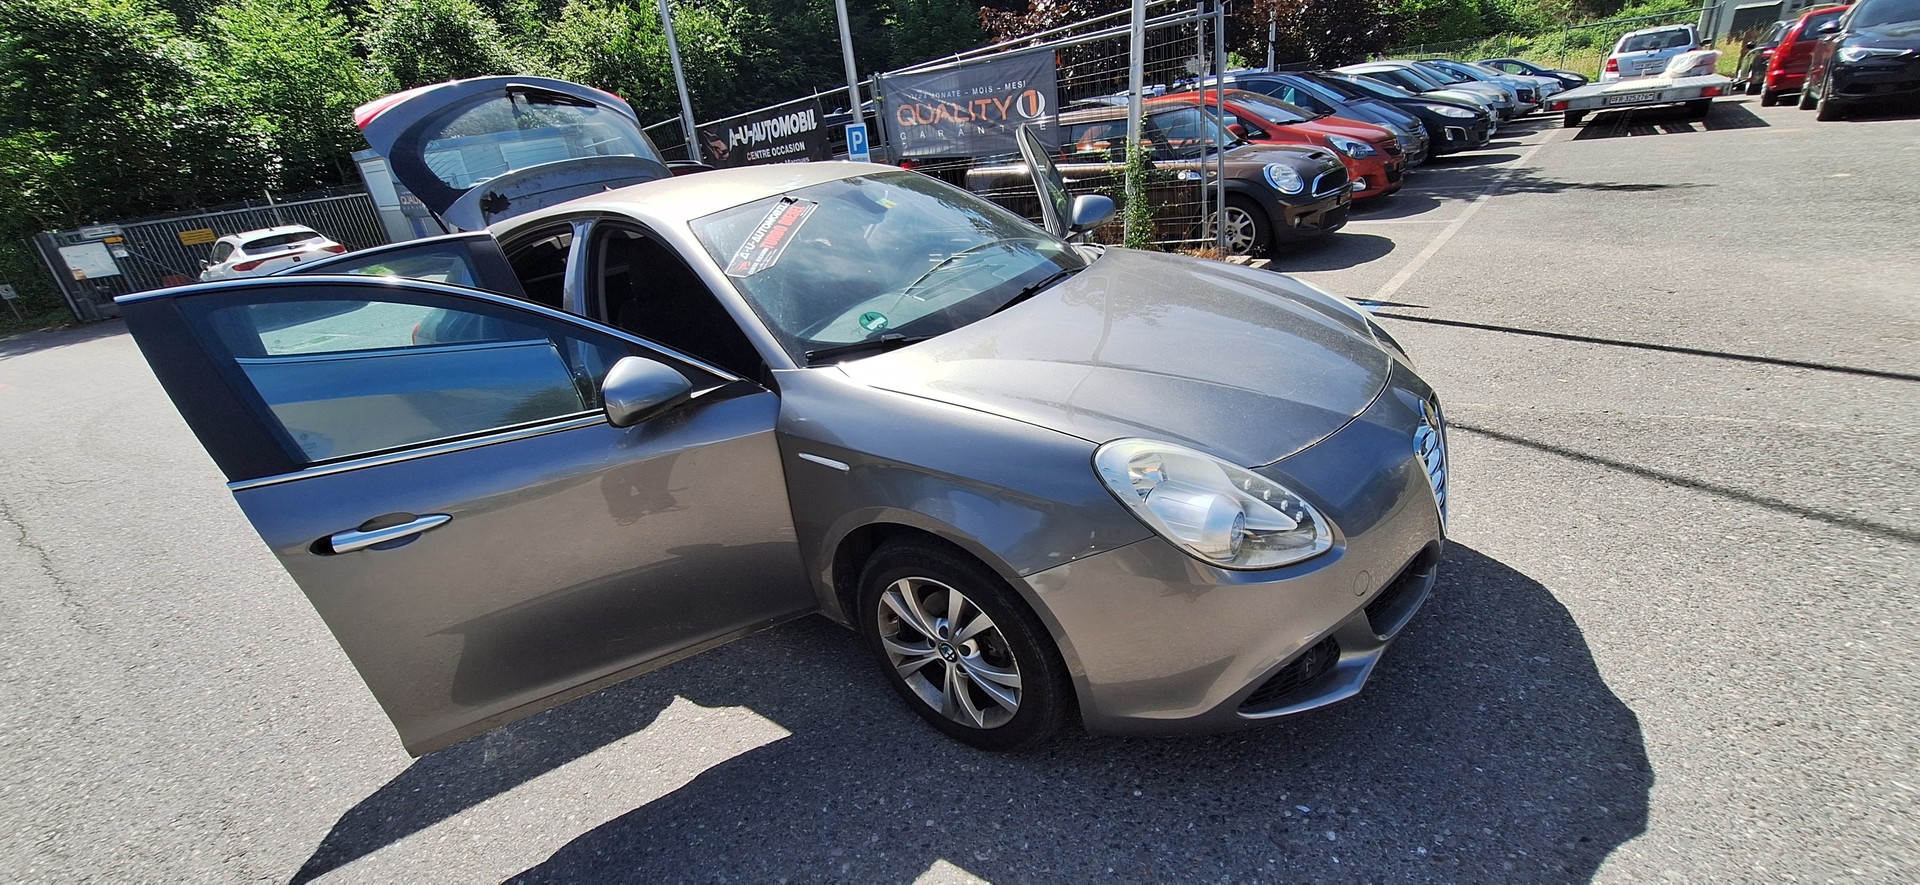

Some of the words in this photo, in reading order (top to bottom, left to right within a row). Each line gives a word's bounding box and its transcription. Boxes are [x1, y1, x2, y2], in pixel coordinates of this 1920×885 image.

[972, 86, 993, 95] MOIS
[1004, 80, 1026, 91] MESI
[896, 94, 1013, 127] QUALITY
[900, 122, 1047, 140] GARANTE
[746, 147, 771, 161] CENTRE
[772, 141, 806, 157] OCCASION
[851, 131, 863, 152] P
